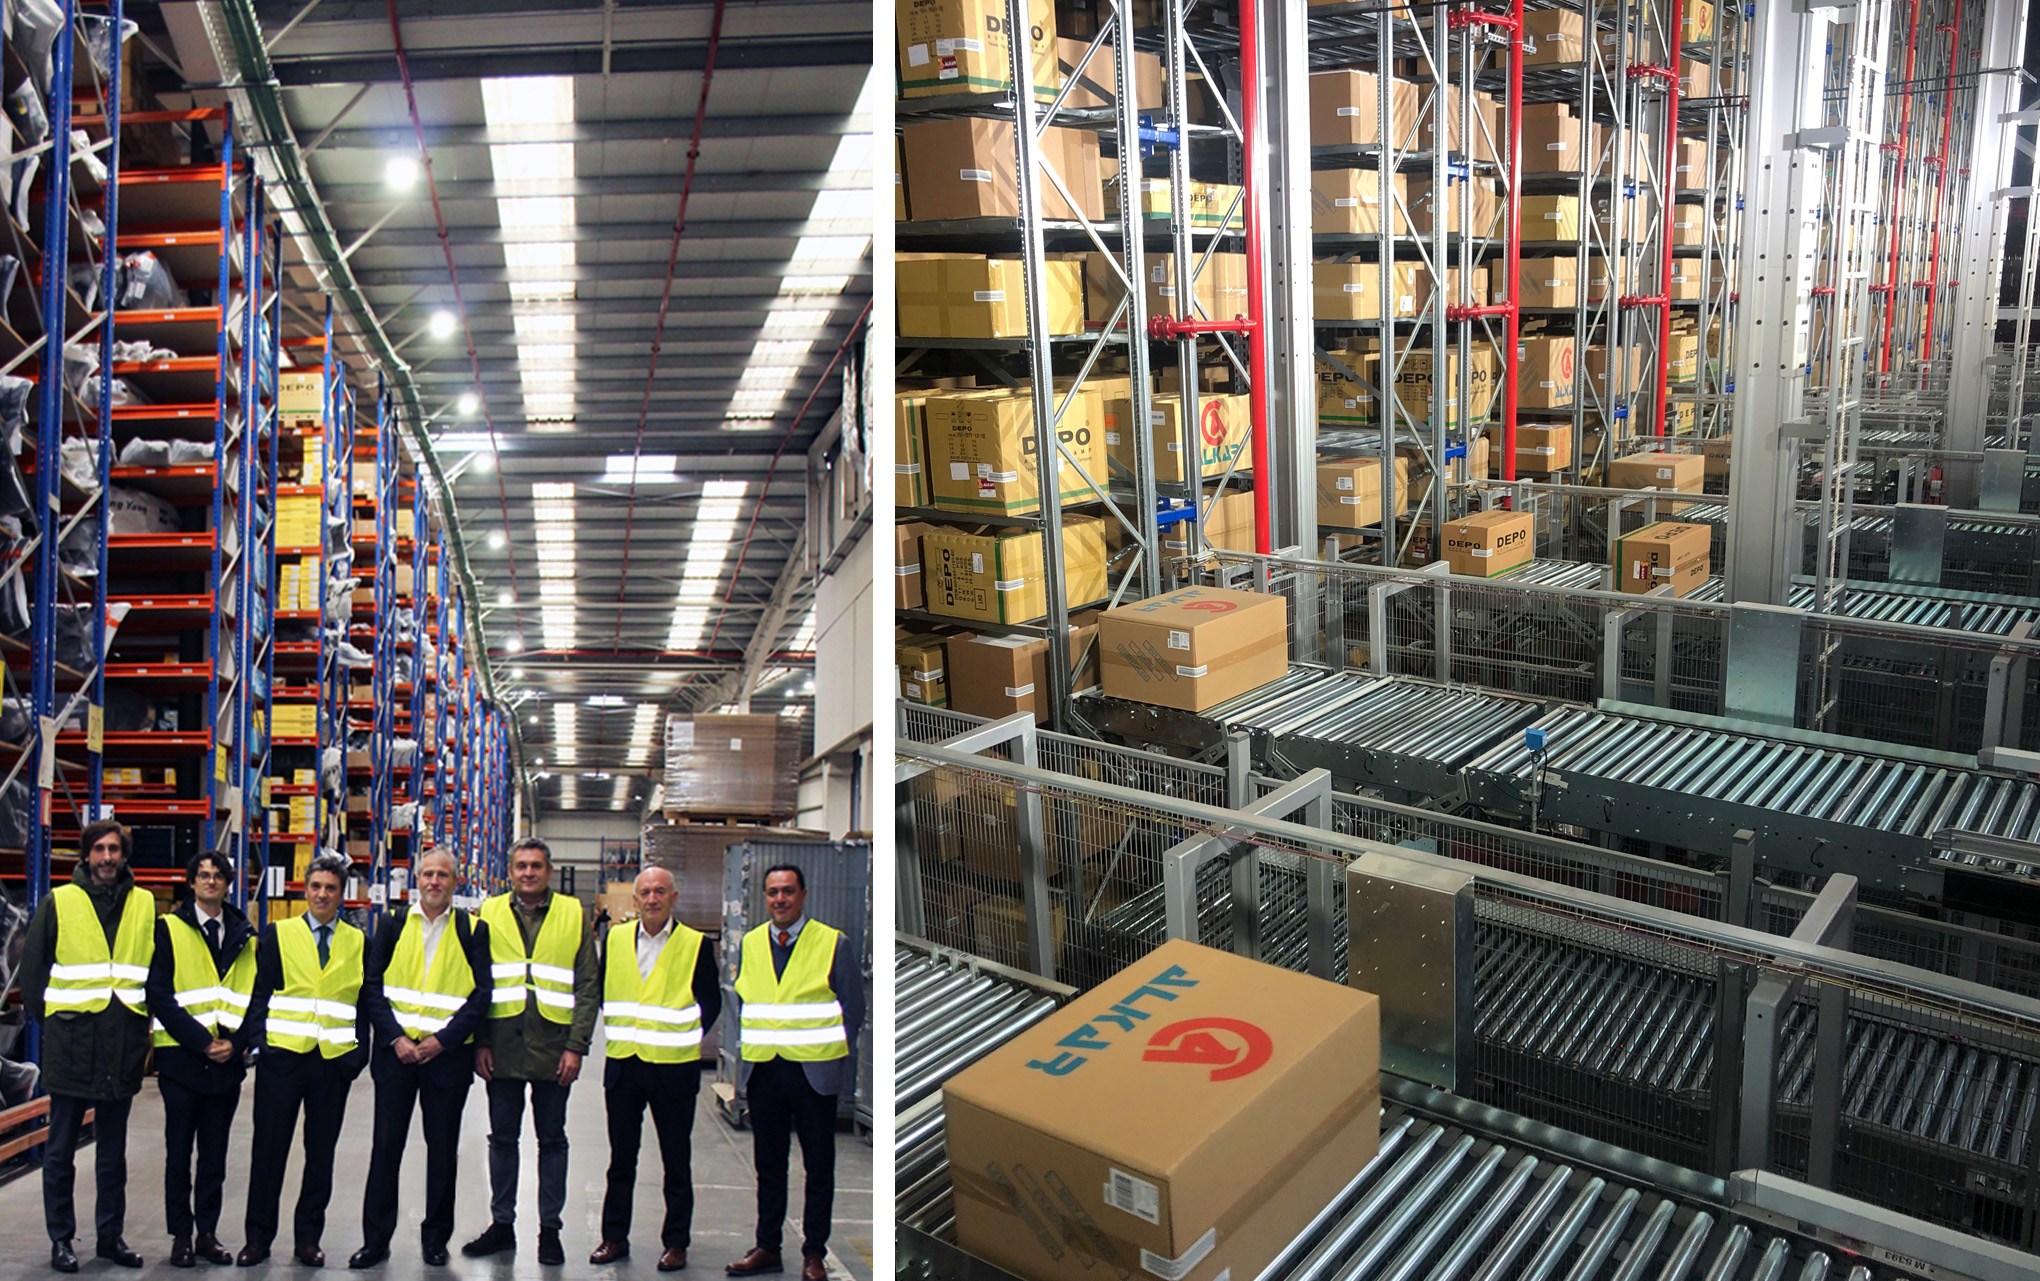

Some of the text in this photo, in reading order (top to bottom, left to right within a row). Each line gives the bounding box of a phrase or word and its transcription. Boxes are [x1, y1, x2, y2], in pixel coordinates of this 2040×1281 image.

[1022, 427, 1091, 456] DPO
[1448, 539, 1481, 550] DEPO
[1496, 529, 1527, 549] DEPO
[942, 548, 955, 607] DEPO
[1690, 564, 1704, 577] DEPO
[1132, 590, 1206, 613] ALKAR
[1024, 964, 1201, 1077] ALKAR
[1885, 1251, 1925, 1271] M 5393
